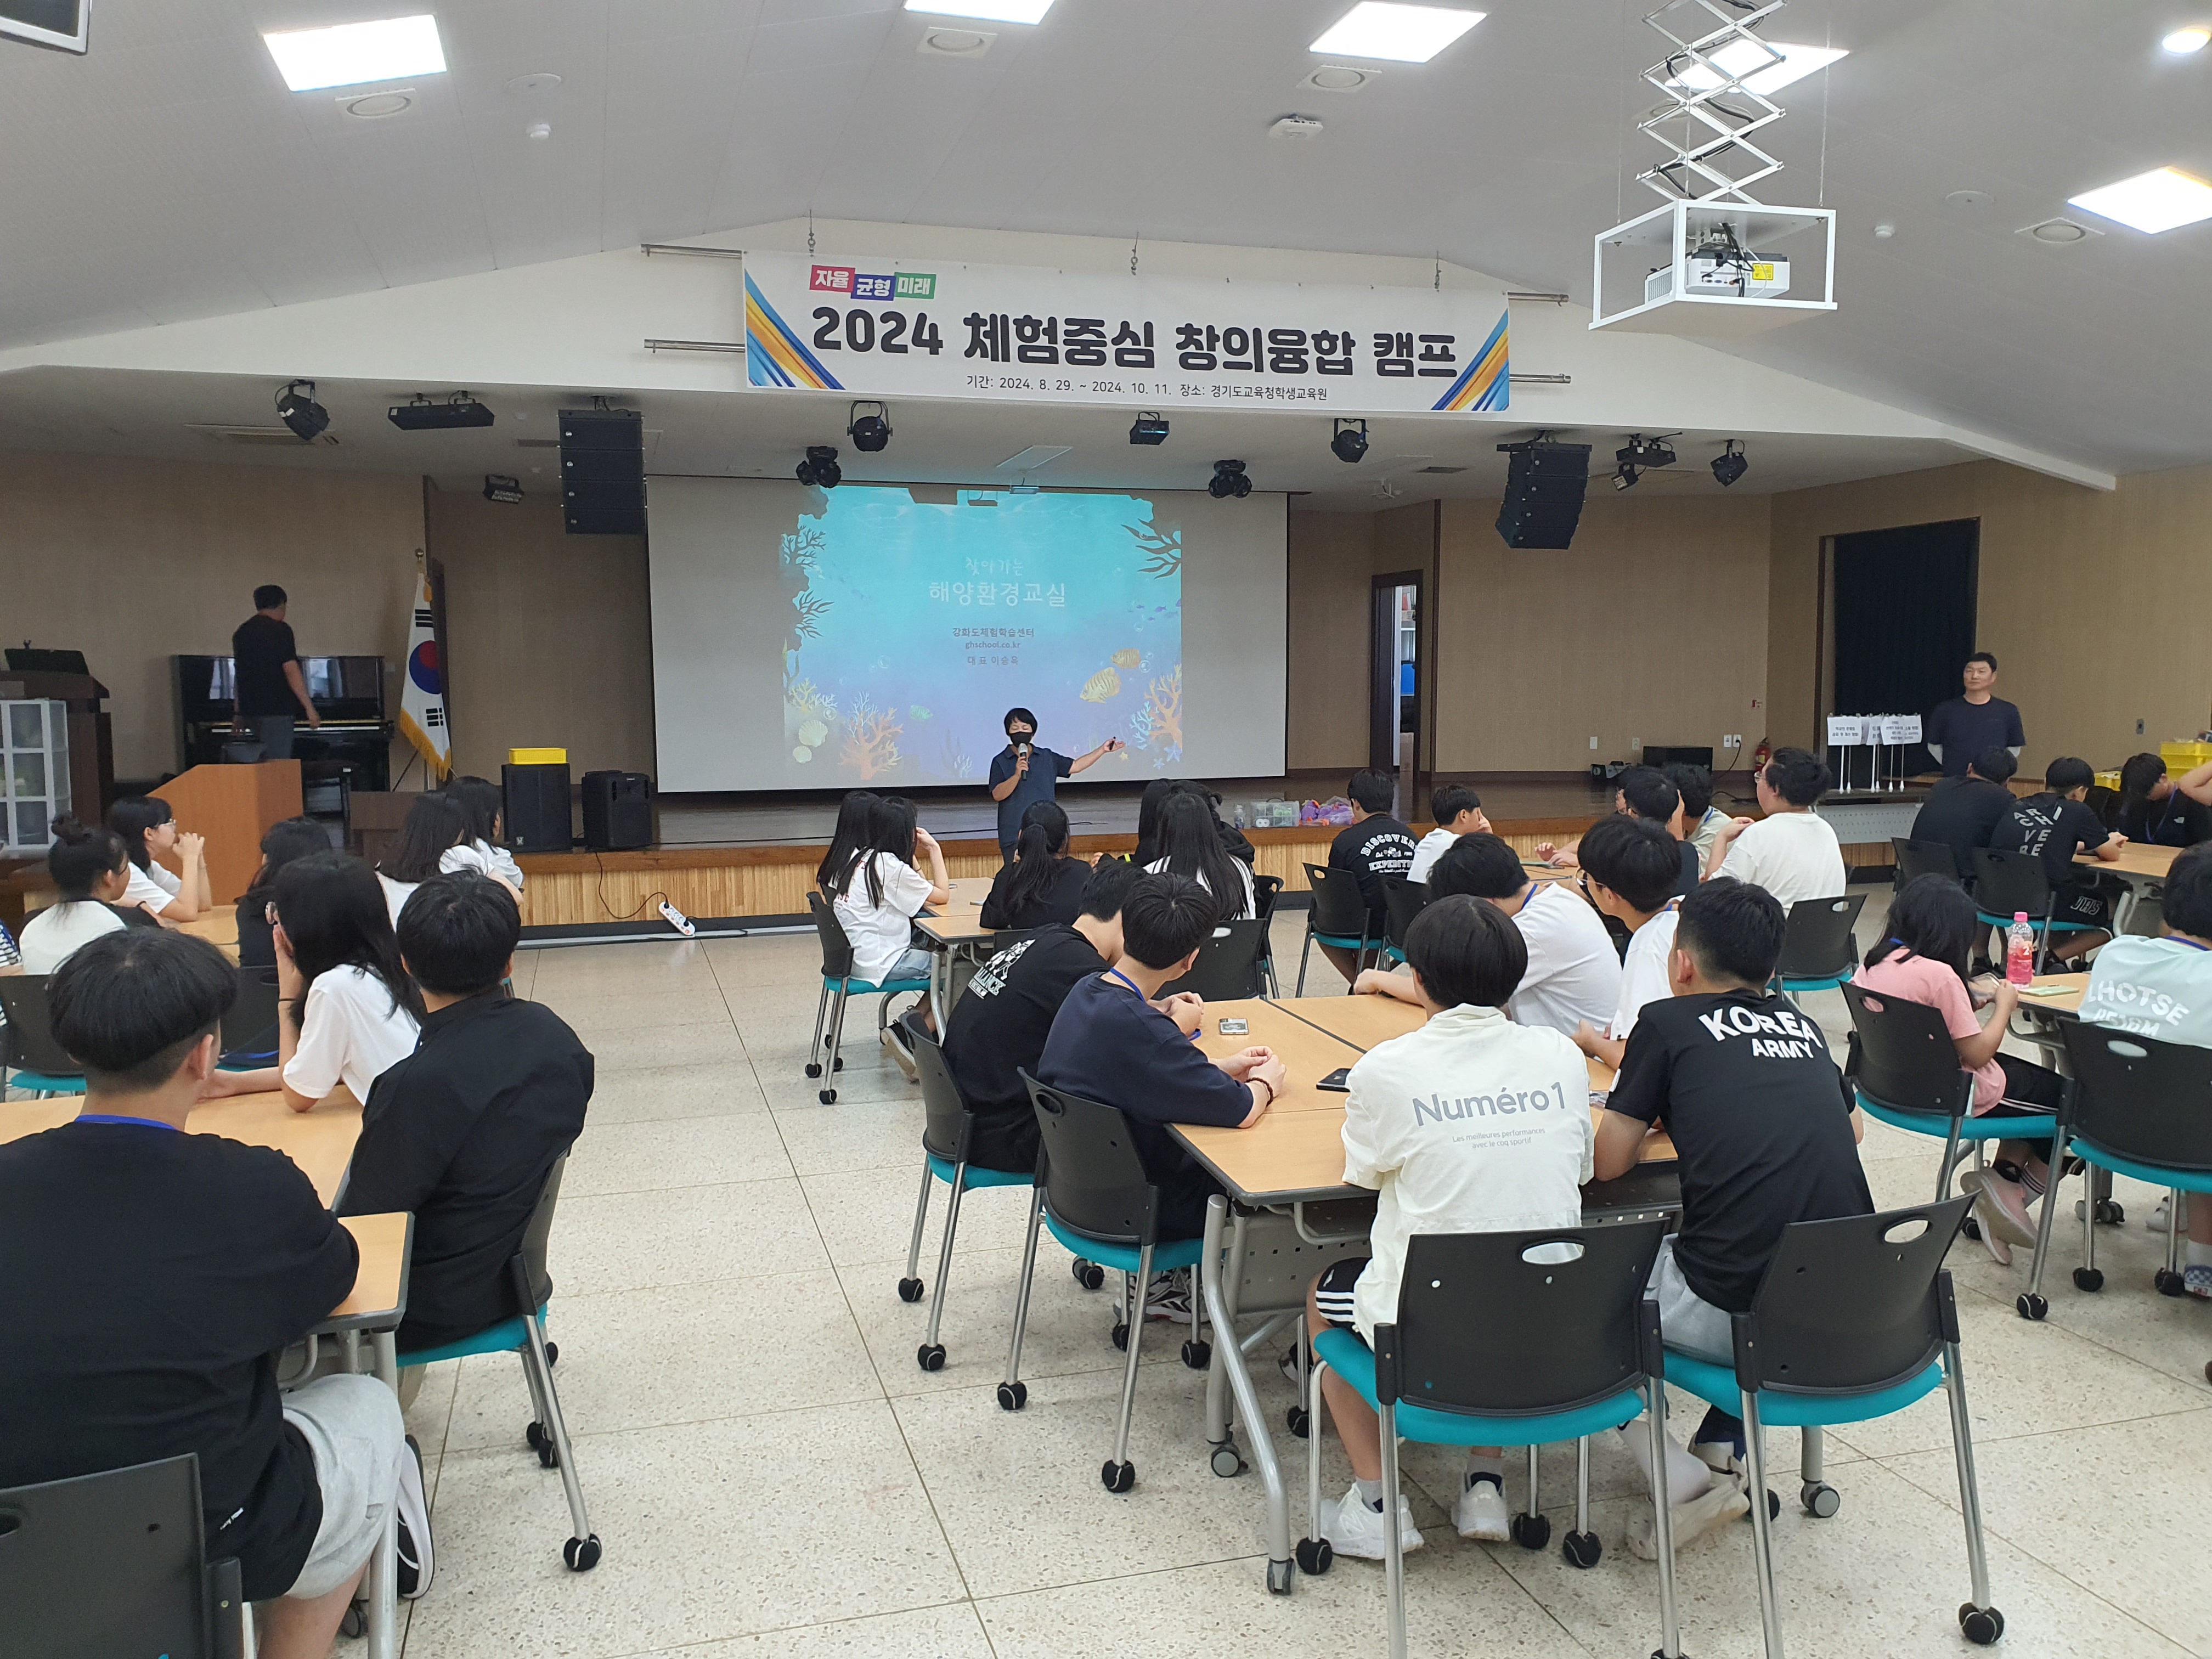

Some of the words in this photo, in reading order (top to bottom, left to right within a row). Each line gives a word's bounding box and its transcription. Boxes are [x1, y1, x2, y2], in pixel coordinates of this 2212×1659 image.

[815, 270, 849, 289] 자율
[856, 278, 891, 297] 균형
[897, 276, 931, 295] 미래
[812, 307, 943, 355] 2024
[963, 312, 1155, 369] 체험중심
[1176, 323, 1356, 375] 창의융합
[1373, 332, 1457, 377] 캠프
[967, 375, 994, 389] 기간:
[1000, 377, 1034, 390] 2024.
[1039, 379, 1050, 391] 8.
[1056, 380, 1074, 391] 29.
[1092, 381, 1125, 393] 2024.
[1131, 382, 1148, 394] 10.
[1154, 383, 1171, 395] 11.
[1180, 383, 1205, 397] 장소:
[1211, 385, 1328, 400] 경기도교육청학생교육원
[965, 556, 1023, 576] 찾아가는
[929, 582, 1065, 607] 해양환경교실
[952, 628, 1034, 637] 강화도체험학습센터
[965, 641, 1020, 650] ghschool.co.kr
[1361, 834, 1418, 856] DISCOVER
[2088, 980, 2191, 1026] LHOTSE
[1699, 1006, 1822, 1048] KOREA
[1752, 1039, 1813, 1058] ARMY
[1466, 1132, 1500, 1141] meilleures
[1502, 1128, 1545, 1138] performances
[1510, 1137, 1532, 1146] sportif
